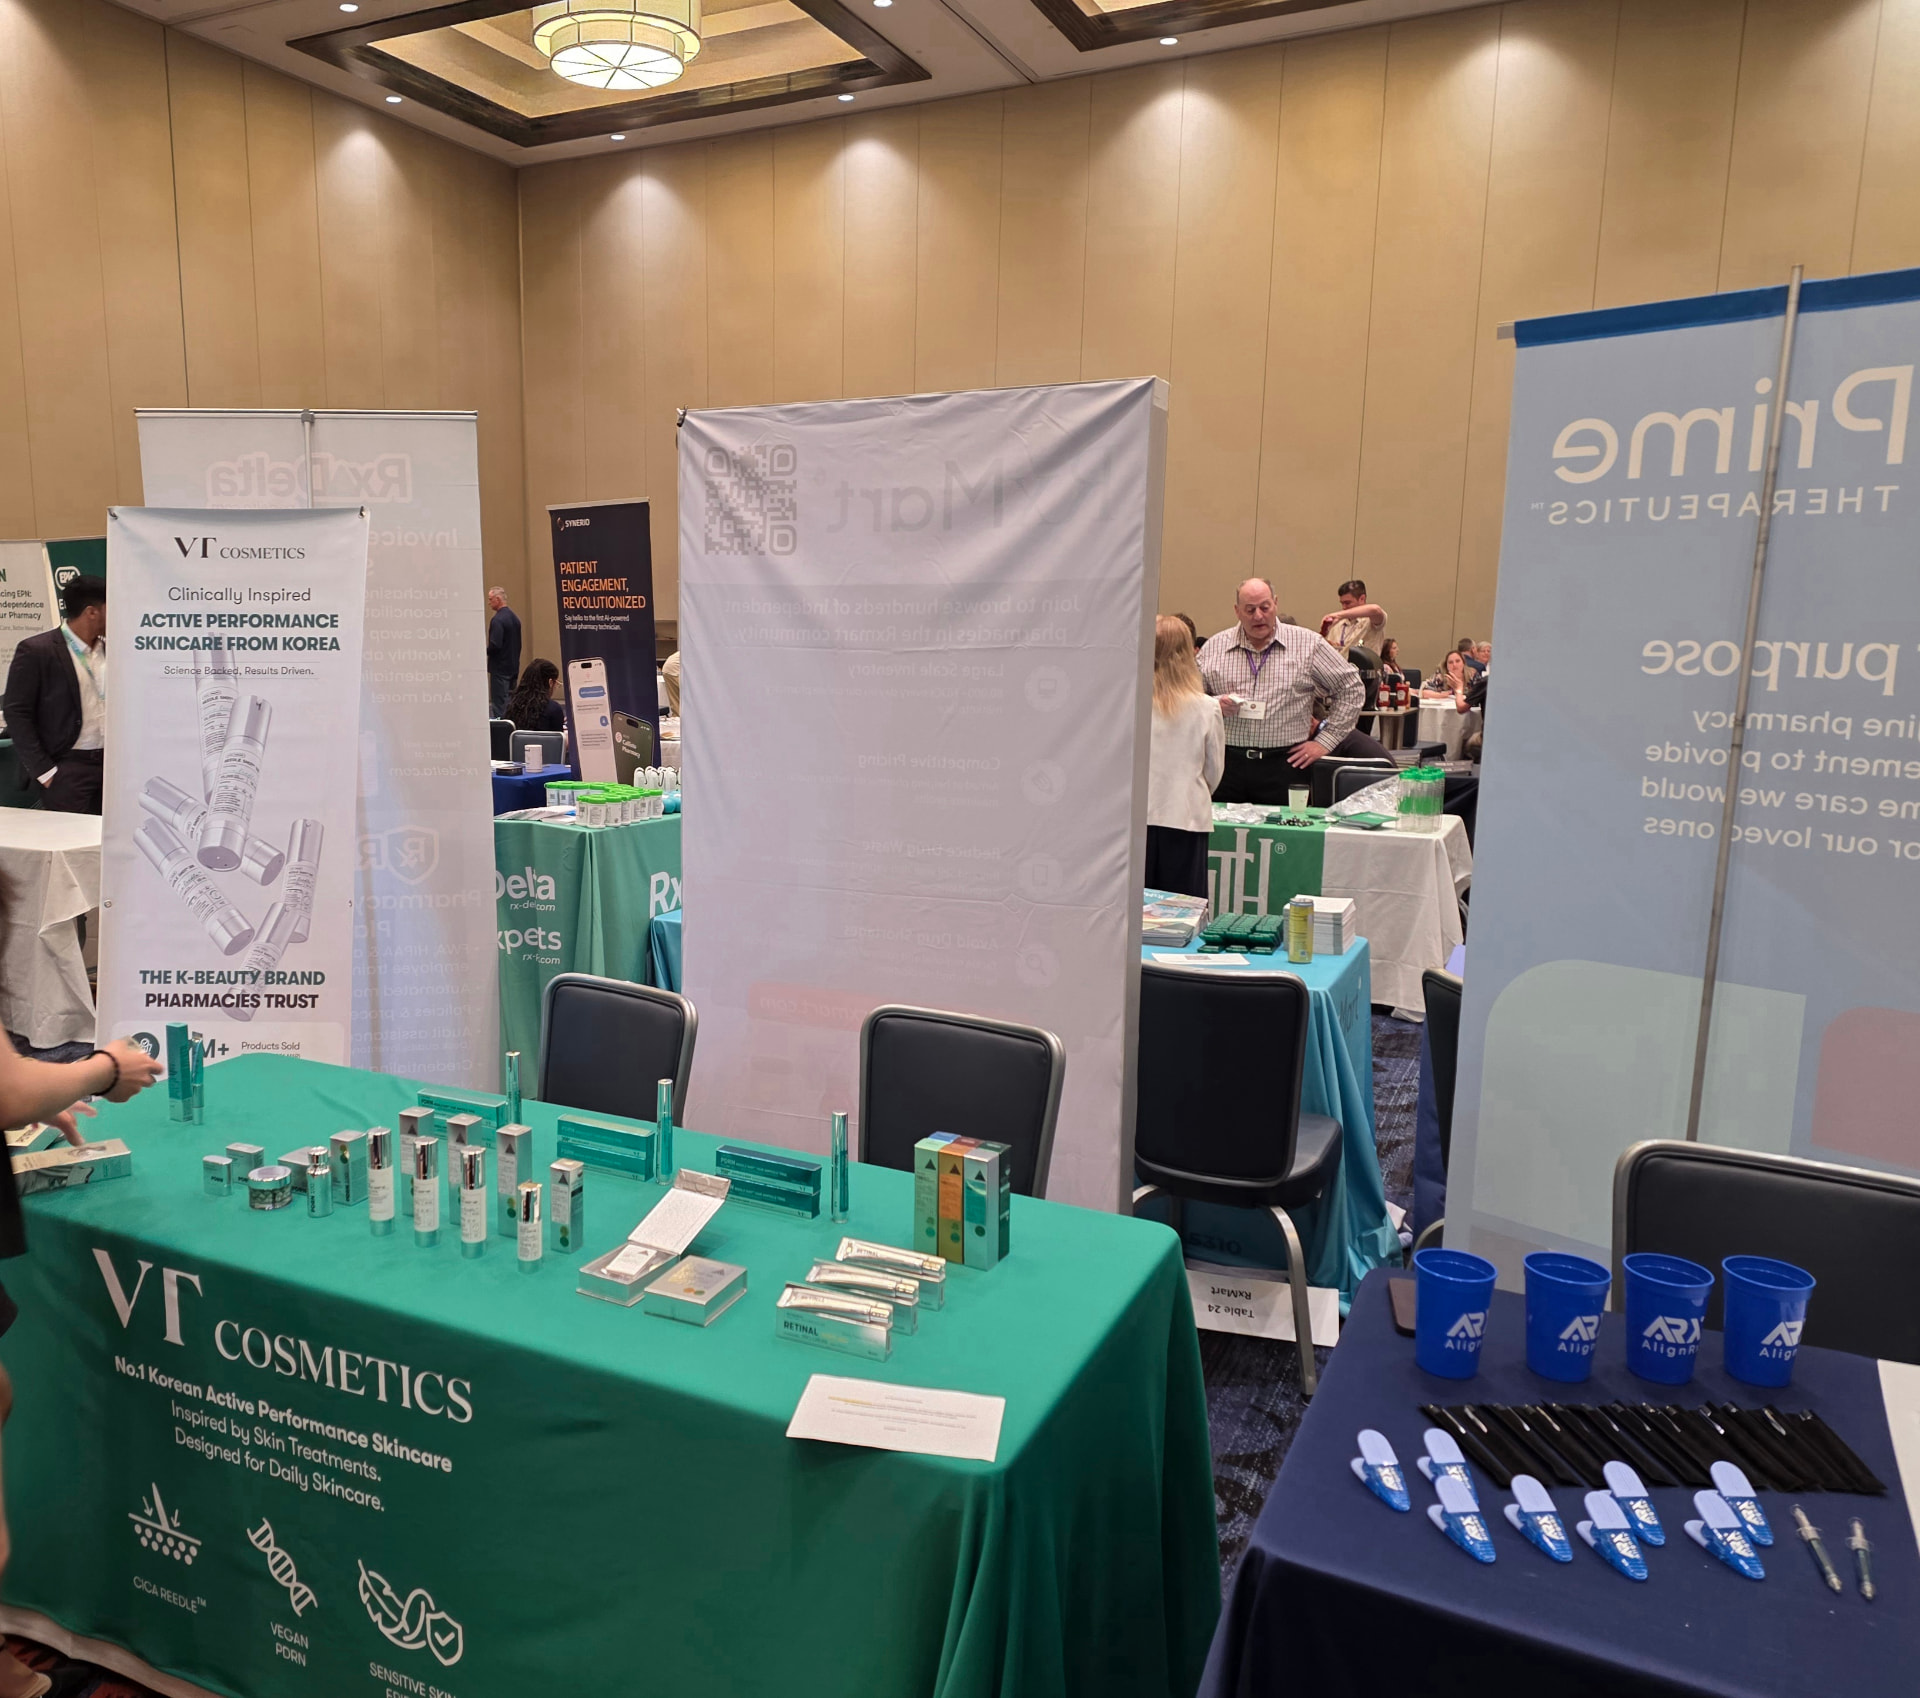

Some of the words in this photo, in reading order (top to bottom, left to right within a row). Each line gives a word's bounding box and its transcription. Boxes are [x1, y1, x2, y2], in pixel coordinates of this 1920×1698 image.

[220, 547, 306, 559] COSMETICS
[560, 561, 598, 574] PATIENT
[561, 578, 629, 592] ENGAGEMENT,
[168, 586, 243, 604] Clinically
[248, 587, 311, 604] Inspired
[563, 595, 646, 609] REVOLUTIONIZED
[140, 613, 202, 628] ACTIVE
[207, 613, 339, 628] PERFORMANCE
[134, 635, 222, 651] SKINCARE
[227, 636, 278, 651] FROM
[282, 636, 341, 651] KOREA
[164, 665, 202, 675] Science
[204, 665, 242, 676] Backed,
[245, 666, 278, 675] Results
[281, 666, 315, 675] Driven.
[497, 927, 562, 955] xpets
[139, 970, 172, 985] THE
[176, 970, 262, 985] K-BEAUTY
[264, 970, 325, 986] BRAND
[145, 993, 261, 1008] PHARMACIES
[264, 993, 319, 1009] TRUST
[241, 1041, 278, 1051] Products
[281, 1041, 300, 1051] Sold
[1211, 1286, 1252, 1300] RxMart
[1208, 1303, 1221, 1314] 24
[1224, 1306, 1255, 1319] Table
[783, 1321, 819, 1337] RETINAL
[214, 1320, 473, 1423] COSMETICS
[115, 1355, 145, 1381] No.1
[148, 1365, 203, 1399] Korean
[206, 1384, 255, 1415] Active
[258, 1400, 368, 1449] Performance
[372, 1432, 452, 1473] Skincare
[171, 1399, 227, 1433] Inspired
[230, 1422, 250, 1445] by
[254, 1427, 285, 1452] Skin
[288, 1436, 382, 1482] Treatments.
[175, 1426, 241, 1466] Designed
[244, 1450, 265, 1473] for
[269, 1458, 308, 1492] Daily
[312, 1472, 385, 1512] Skincare.
[133, 1575, 159, 1598] CICA
[270, 1622, 309, 1650] VEGAN
[275, 1642, 306, 1667] PDRN
[369, 1662, 426, 1697] SENSITIVE
